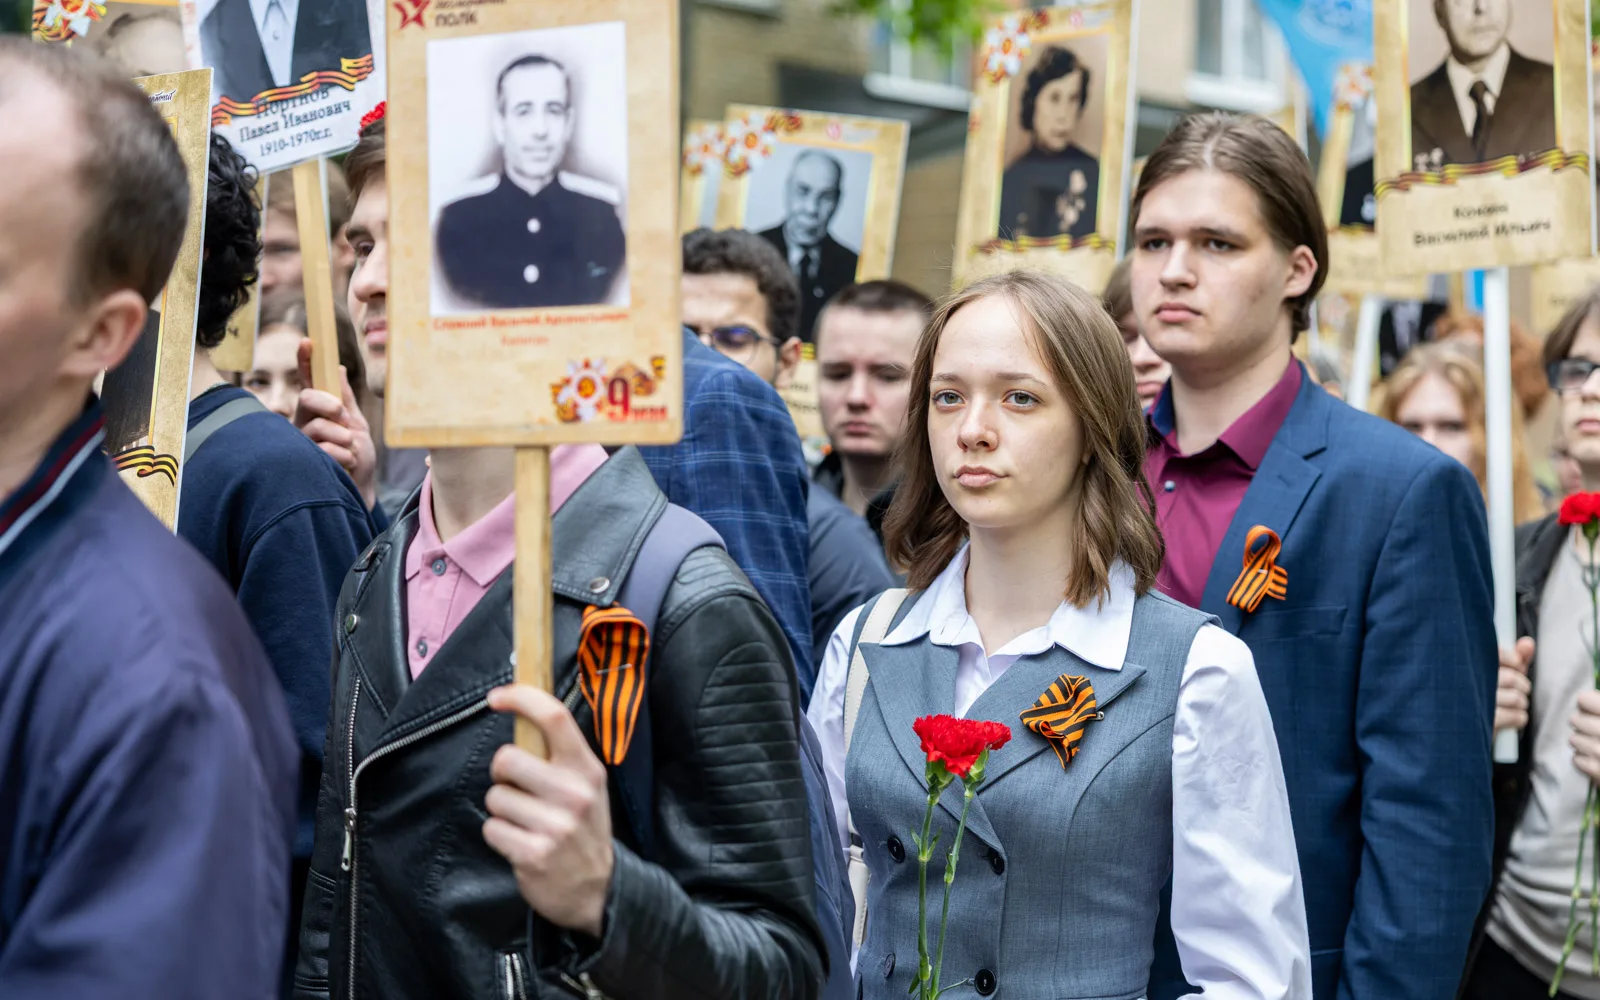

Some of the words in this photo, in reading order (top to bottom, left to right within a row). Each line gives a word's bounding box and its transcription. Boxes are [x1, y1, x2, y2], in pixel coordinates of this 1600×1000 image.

[239, 121, 280, 143] Павел
[283, 100, 351, 129] Иванович
[608, 376, 629, 422] 9
